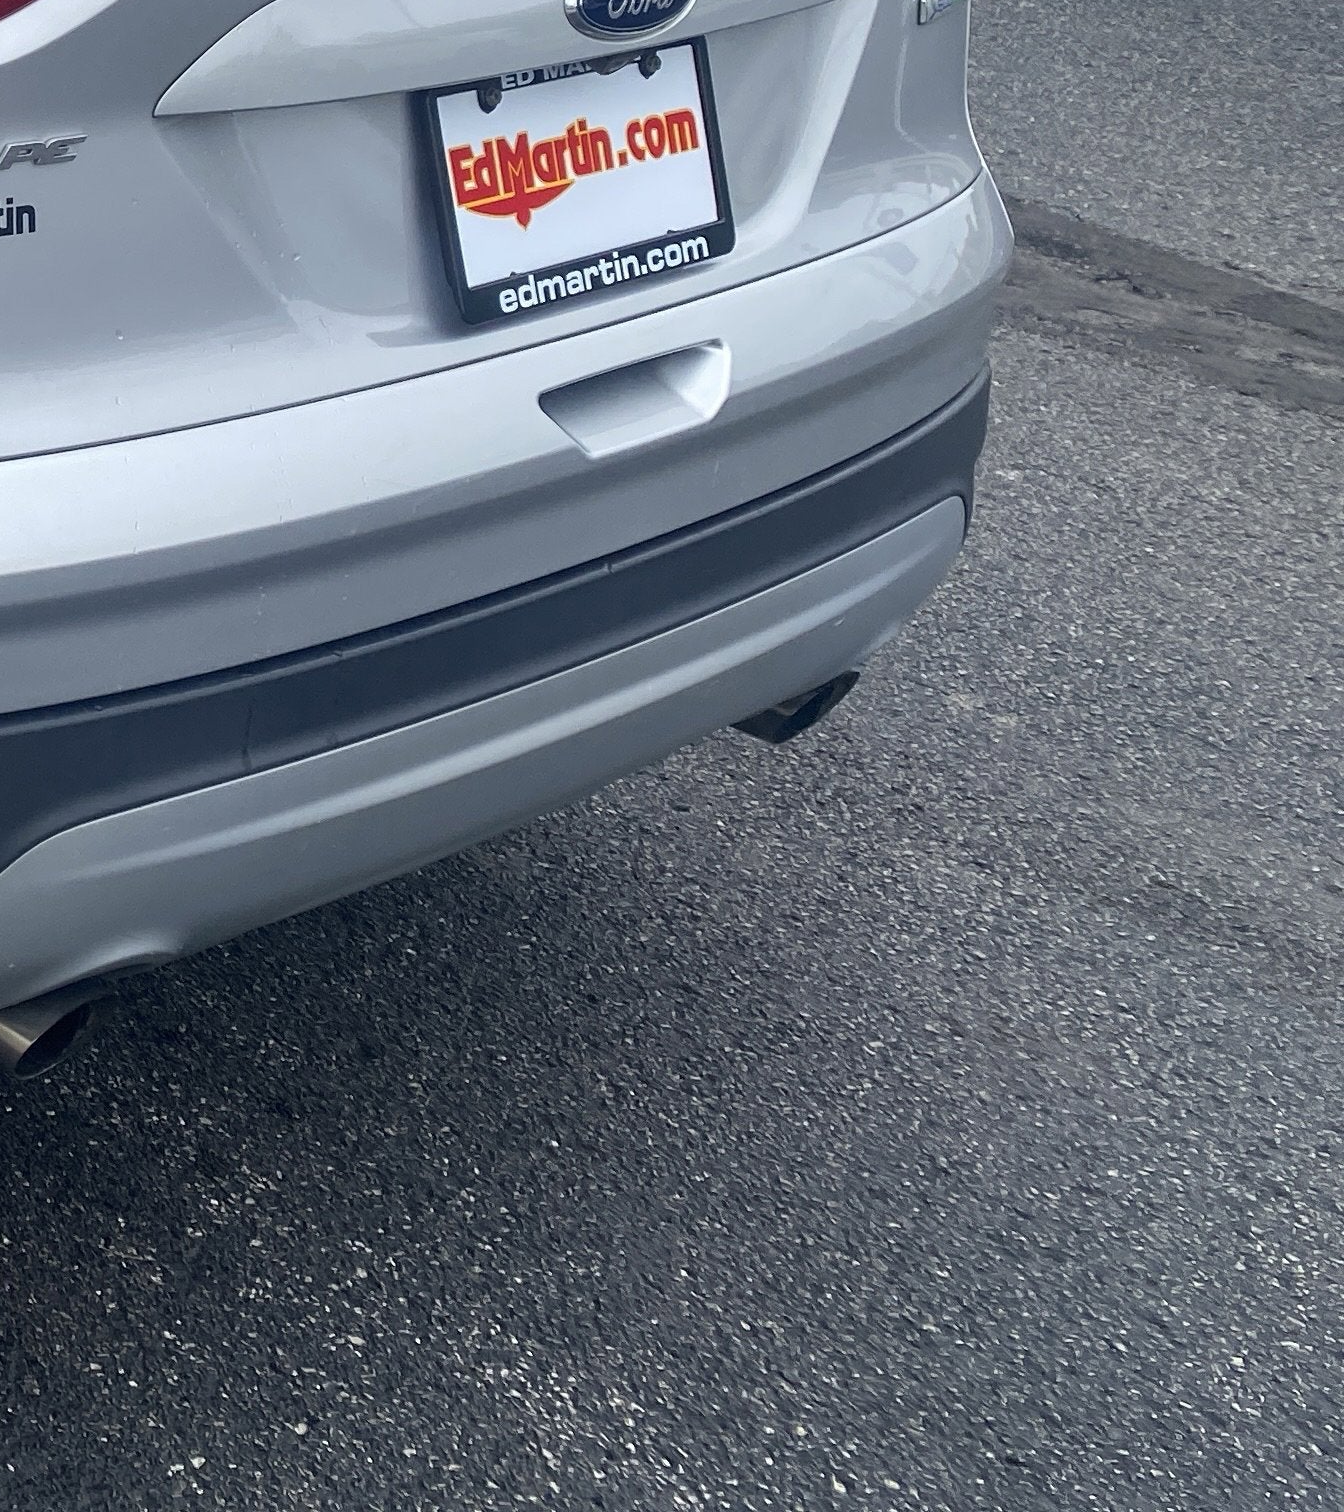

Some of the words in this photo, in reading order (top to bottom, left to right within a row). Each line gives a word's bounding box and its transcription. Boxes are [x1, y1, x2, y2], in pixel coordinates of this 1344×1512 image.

[500, 69, 535, 89] ED
[448, 107, 700, 207] EdMartin.com
[498, 234, 710, 314] edmartin.com
